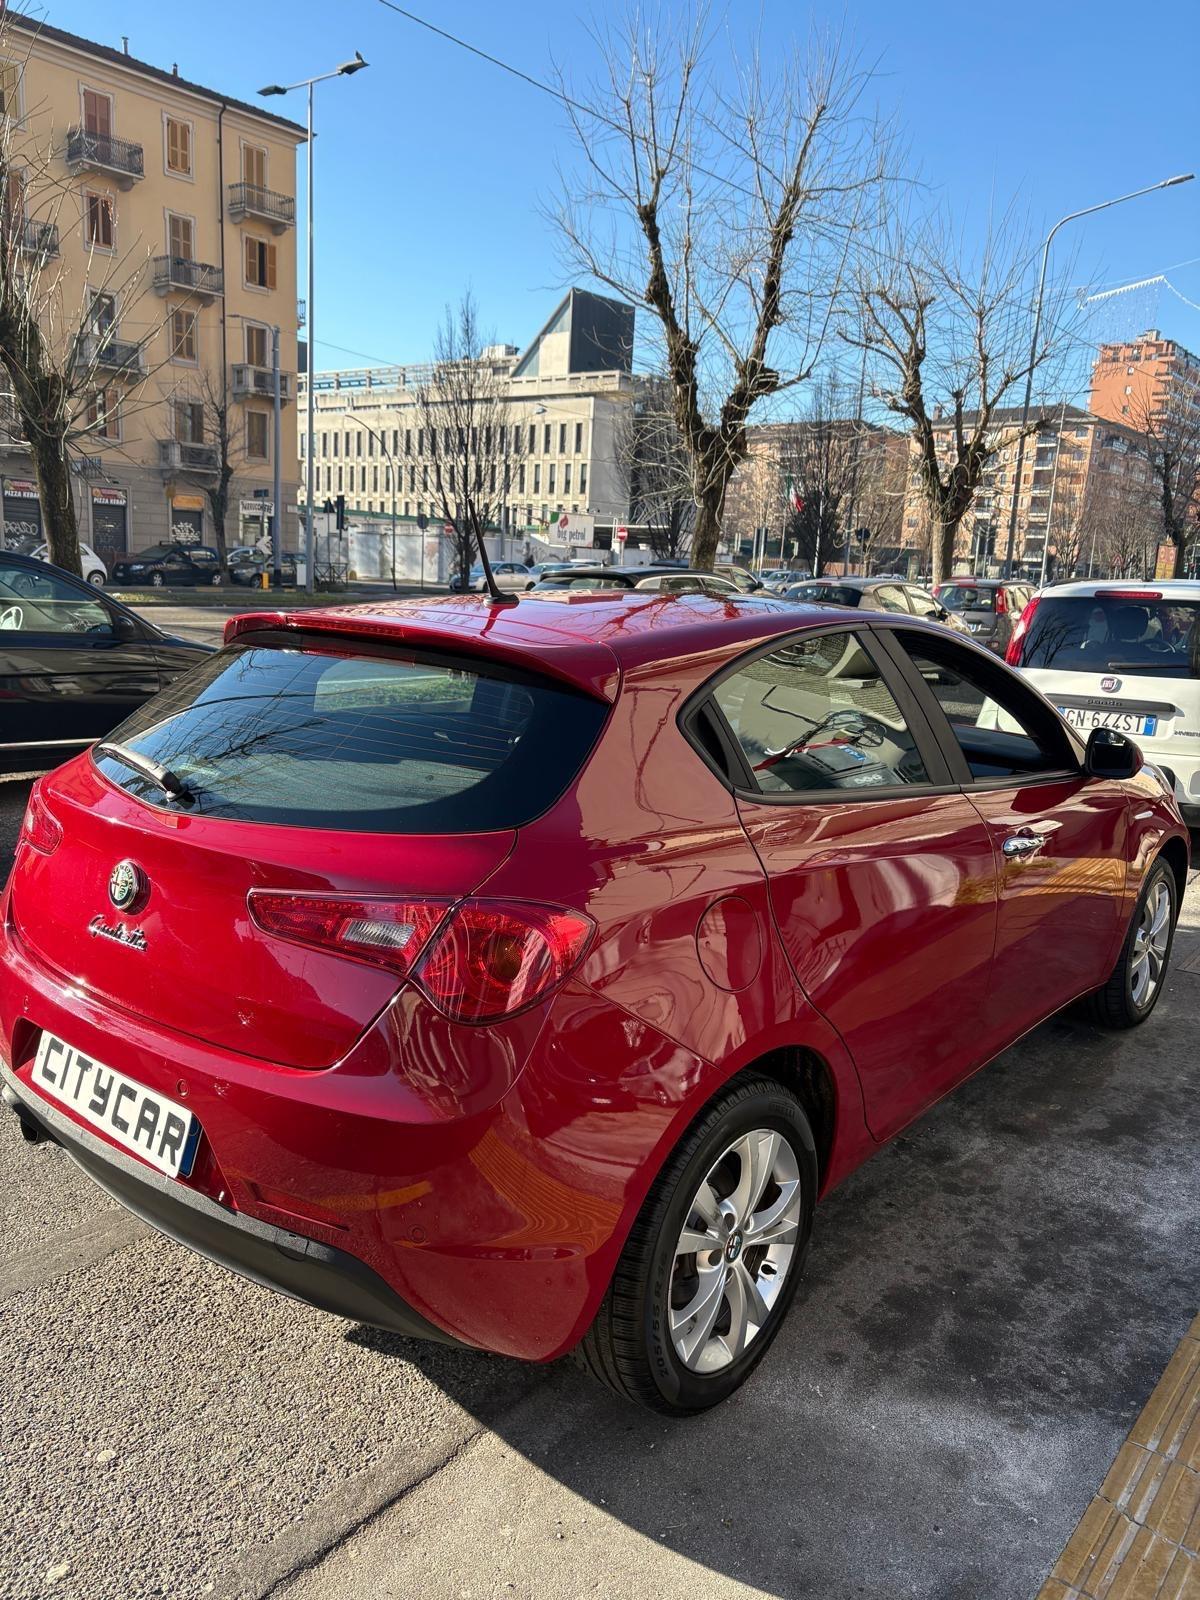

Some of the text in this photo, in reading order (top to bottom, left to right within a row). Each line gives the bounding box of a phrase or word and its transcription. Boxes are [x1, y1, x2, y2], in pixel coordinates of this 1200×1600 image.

[568, 527, 586, 542] petrol
[1066, 710, 1145, 733] GN 644ST
[41, 1037, 186, 1167] CITYCAR
